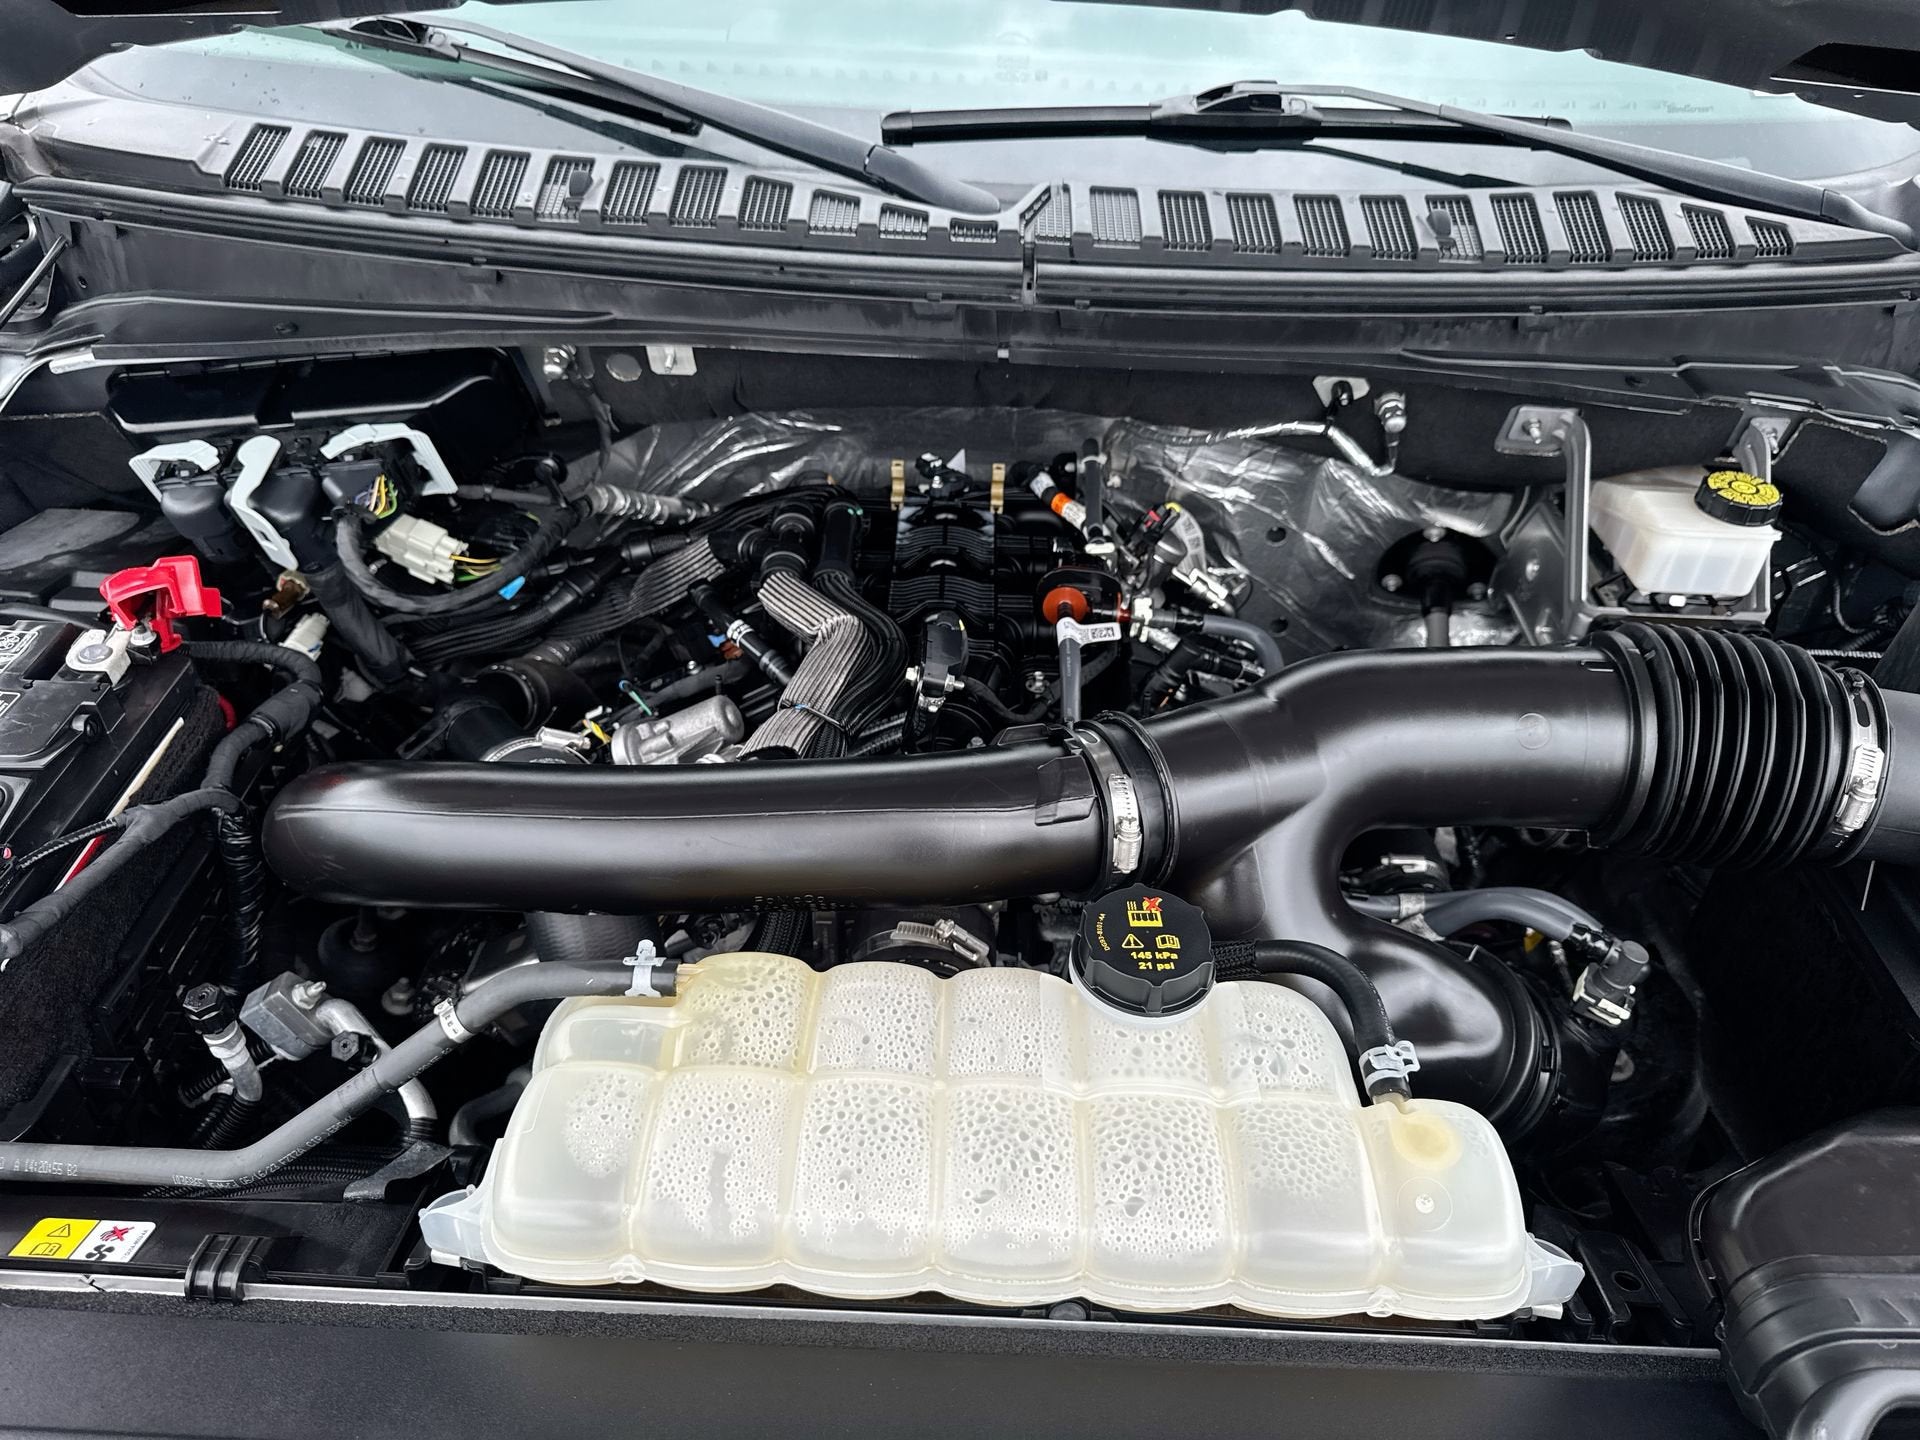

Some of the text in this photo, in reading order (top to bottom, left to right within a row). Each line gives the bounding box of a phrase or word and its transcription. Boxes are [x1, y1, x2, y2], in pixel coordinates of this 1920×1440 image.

[1130, 951, 1178, 960] 145 kPa
[1138, 962, 1175, 972] 21 psi
